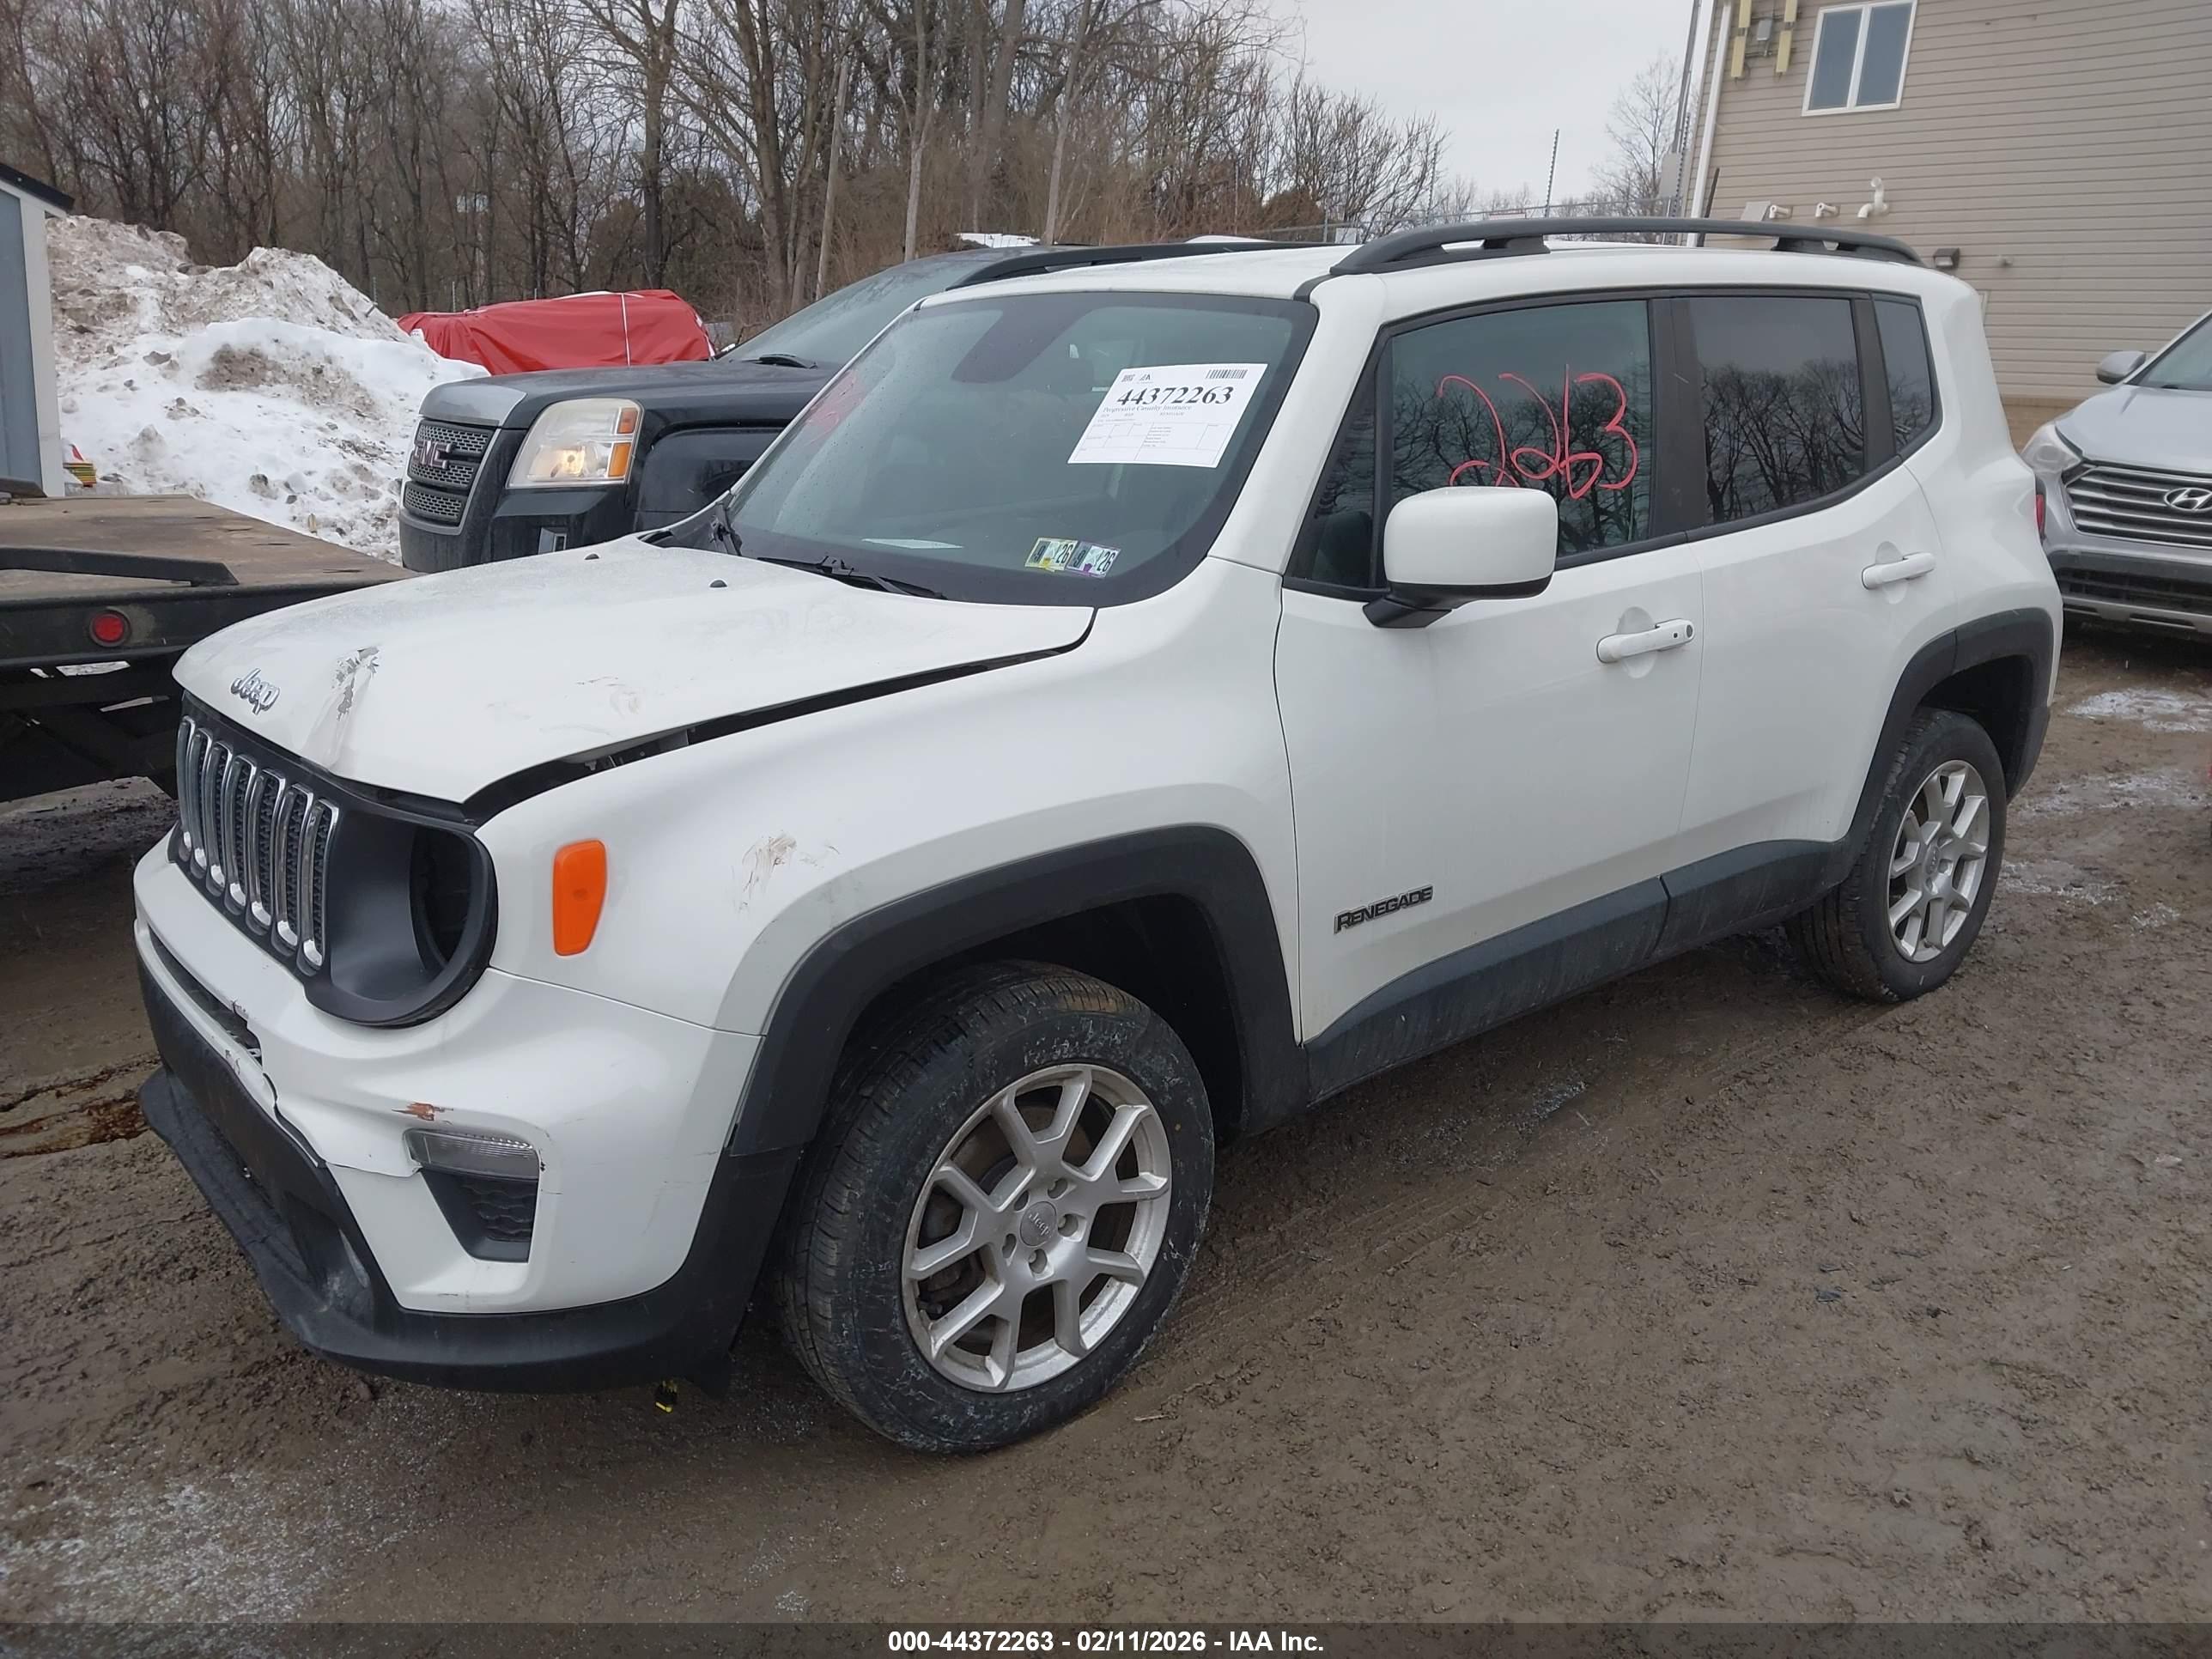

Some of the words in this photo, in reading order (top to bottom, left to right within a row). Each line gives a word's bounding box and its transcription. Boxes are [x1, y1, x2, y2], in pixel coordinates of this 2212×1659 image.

[1117, 386, 1235, 405] 44372263
[412, 439, 457, 470] GMC
[1055, 544, 1074, 564] 26
[1097, 551, 1115, 573] 26
[230, 668, 281, 715] Jeep
[1334, 884, 1433, 934] RENEGADE
[1028, 1212, 1049, 1237] Jeep
